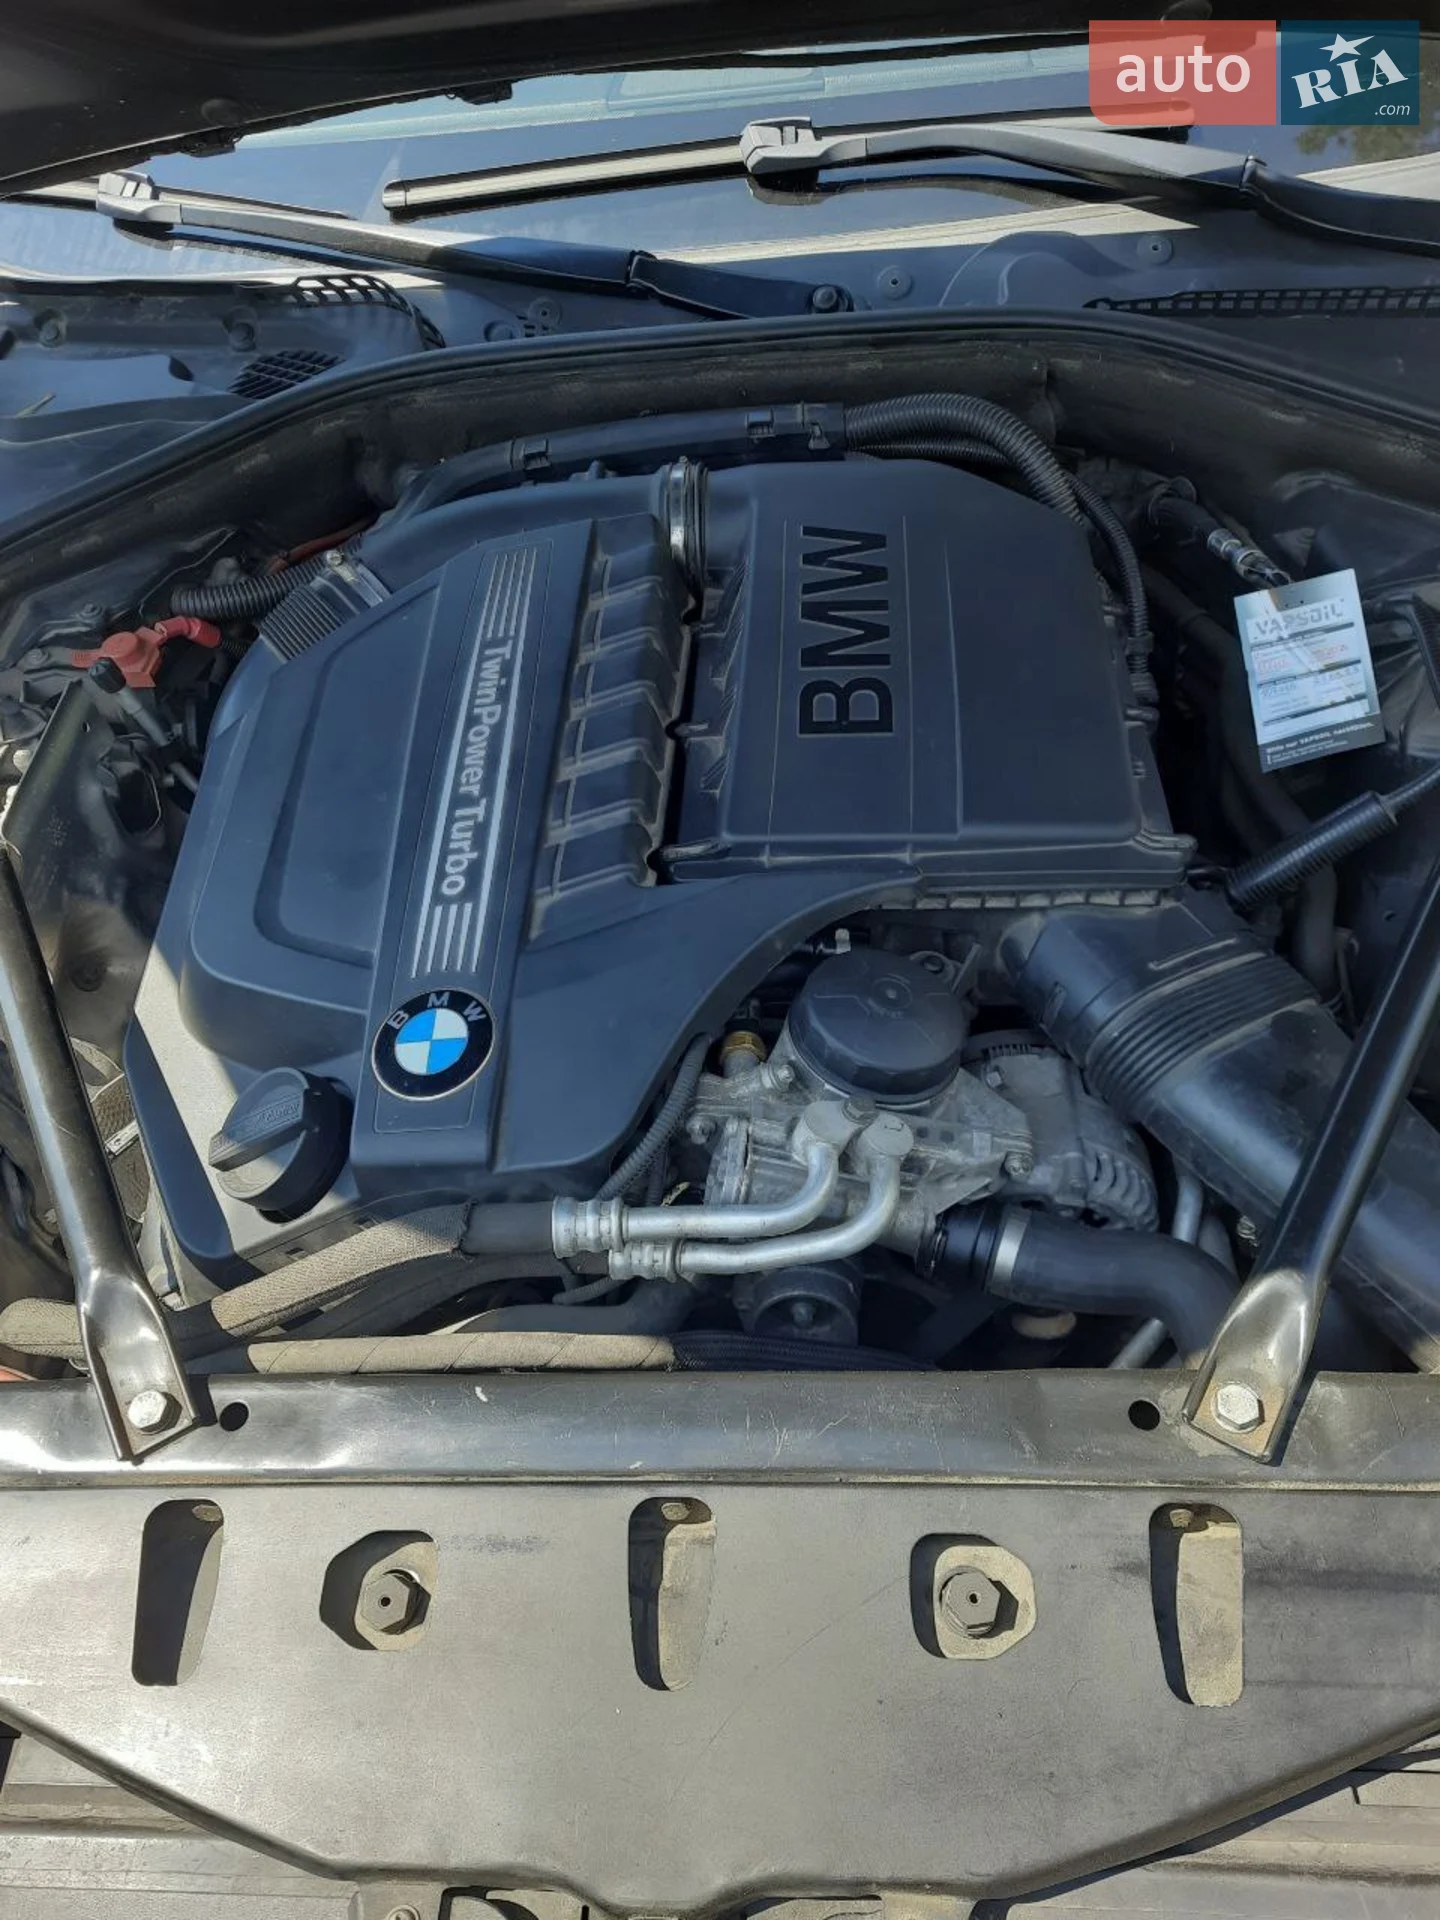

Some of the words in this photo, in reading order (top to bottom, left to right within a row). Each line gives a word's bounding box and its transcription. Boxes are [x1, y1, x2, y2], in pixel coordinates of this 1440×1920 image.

[798, 525, 894, 736] BMW
[459, 640, 513, 796] TwinPower
[441, 798, 486, 896] Turbo
[387, 991, 487, 1030] BMW
